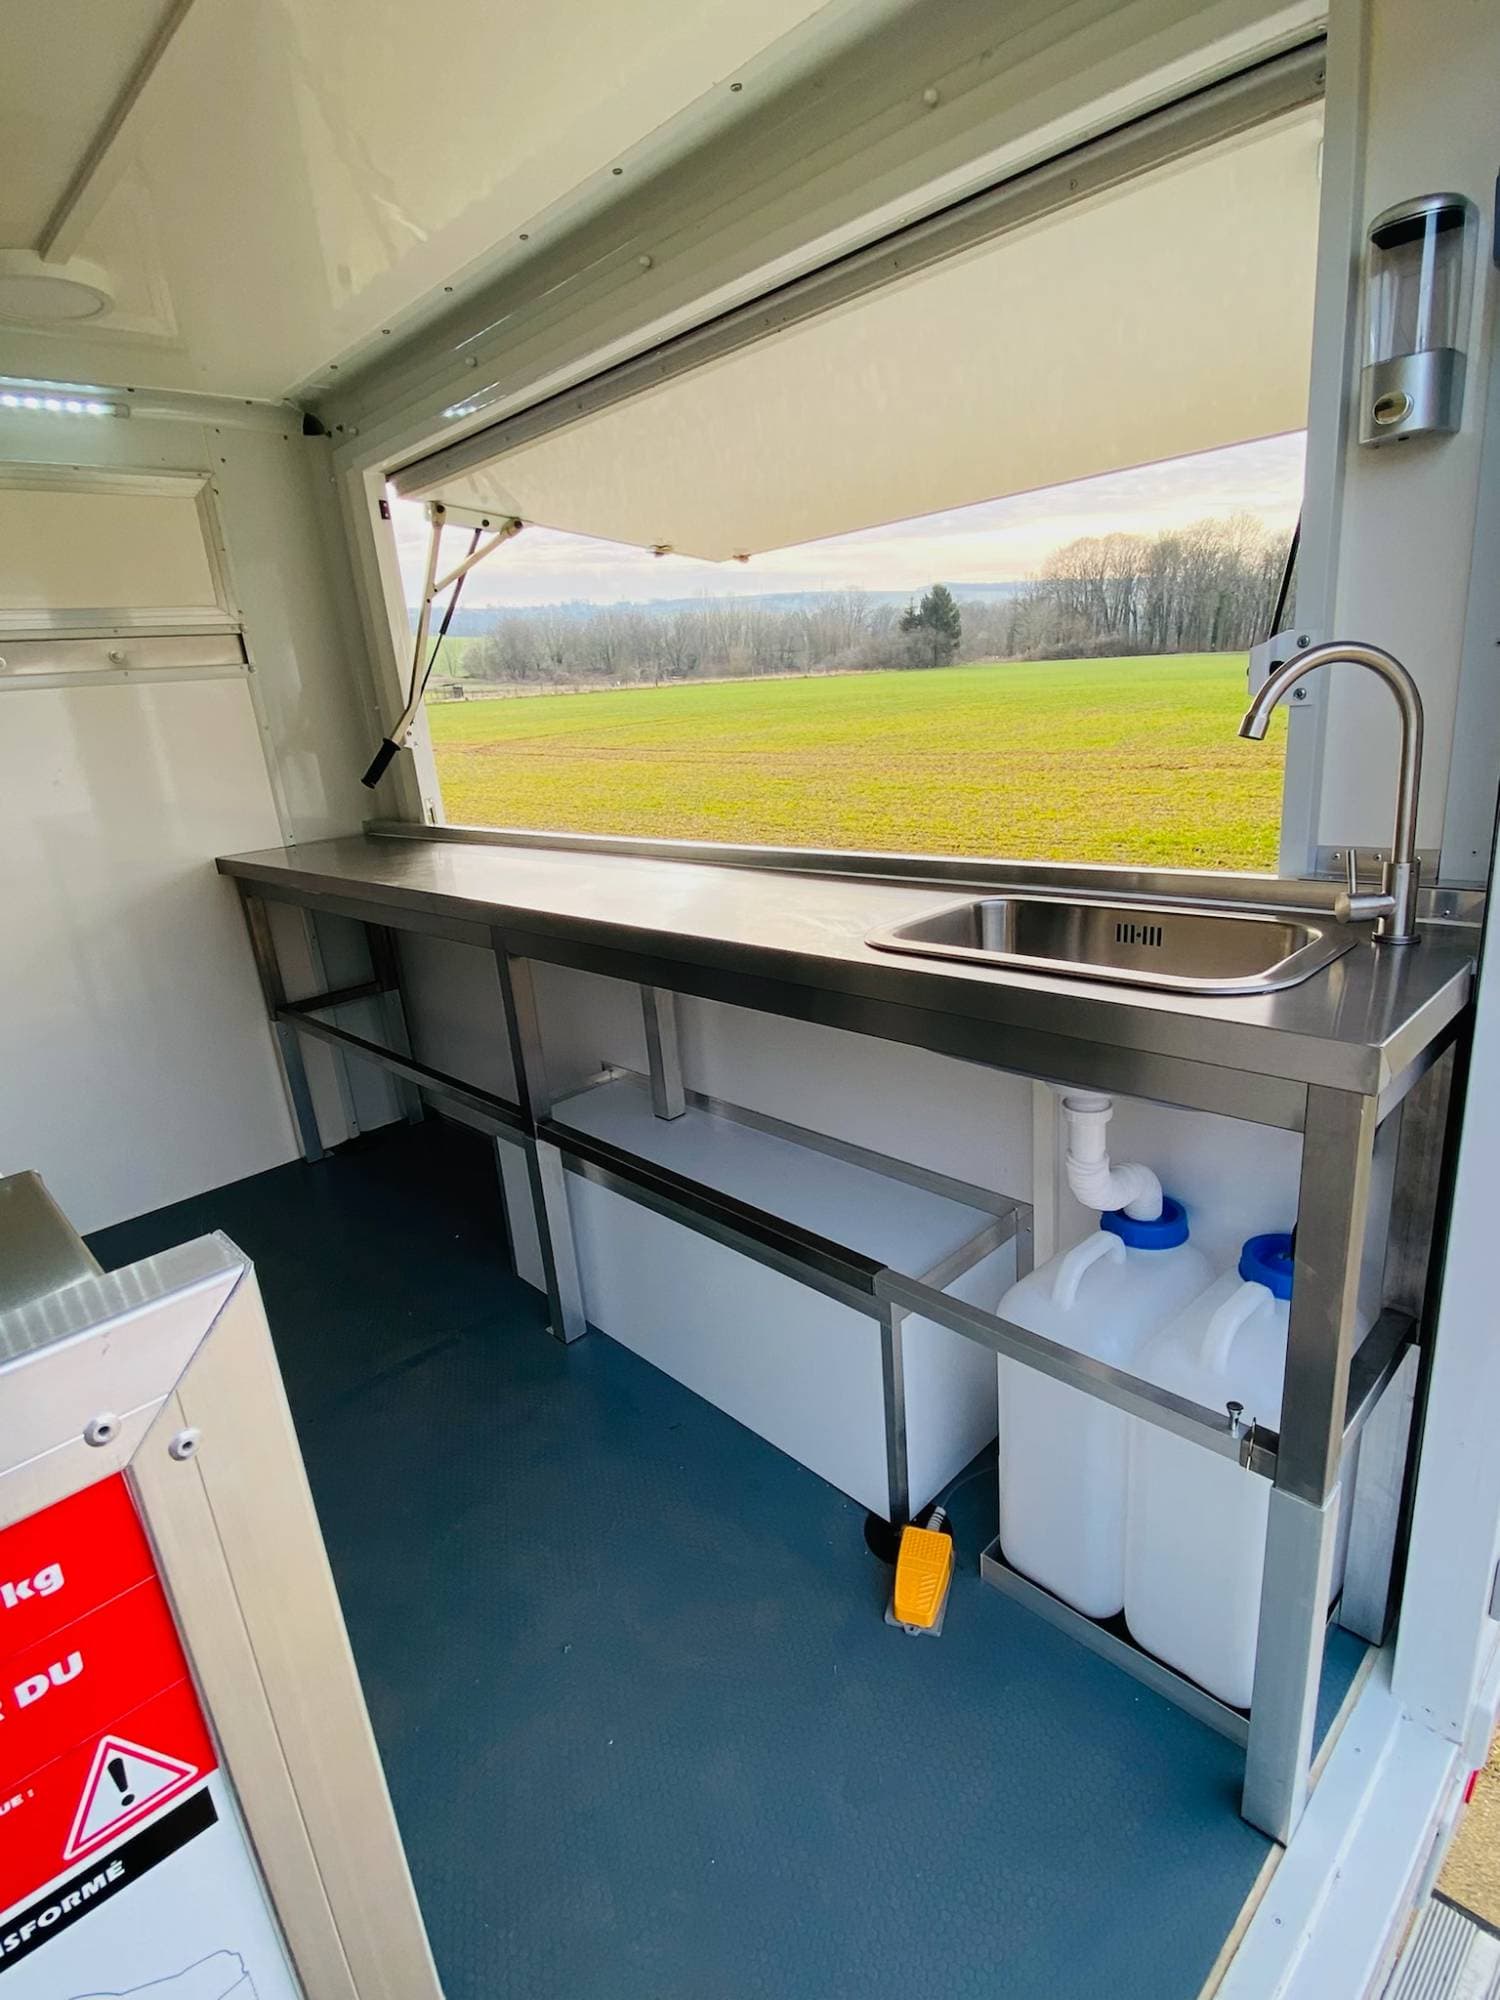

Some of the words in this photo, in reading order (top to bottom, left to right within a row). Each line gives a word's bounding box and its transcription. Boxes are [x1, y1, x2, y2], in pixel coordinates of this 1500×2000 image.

[0, 1562, 65, 1608] kg
[14, 1651, 84, 1709] DU
[0, 1860, 125, 1958] SFORMÉ
